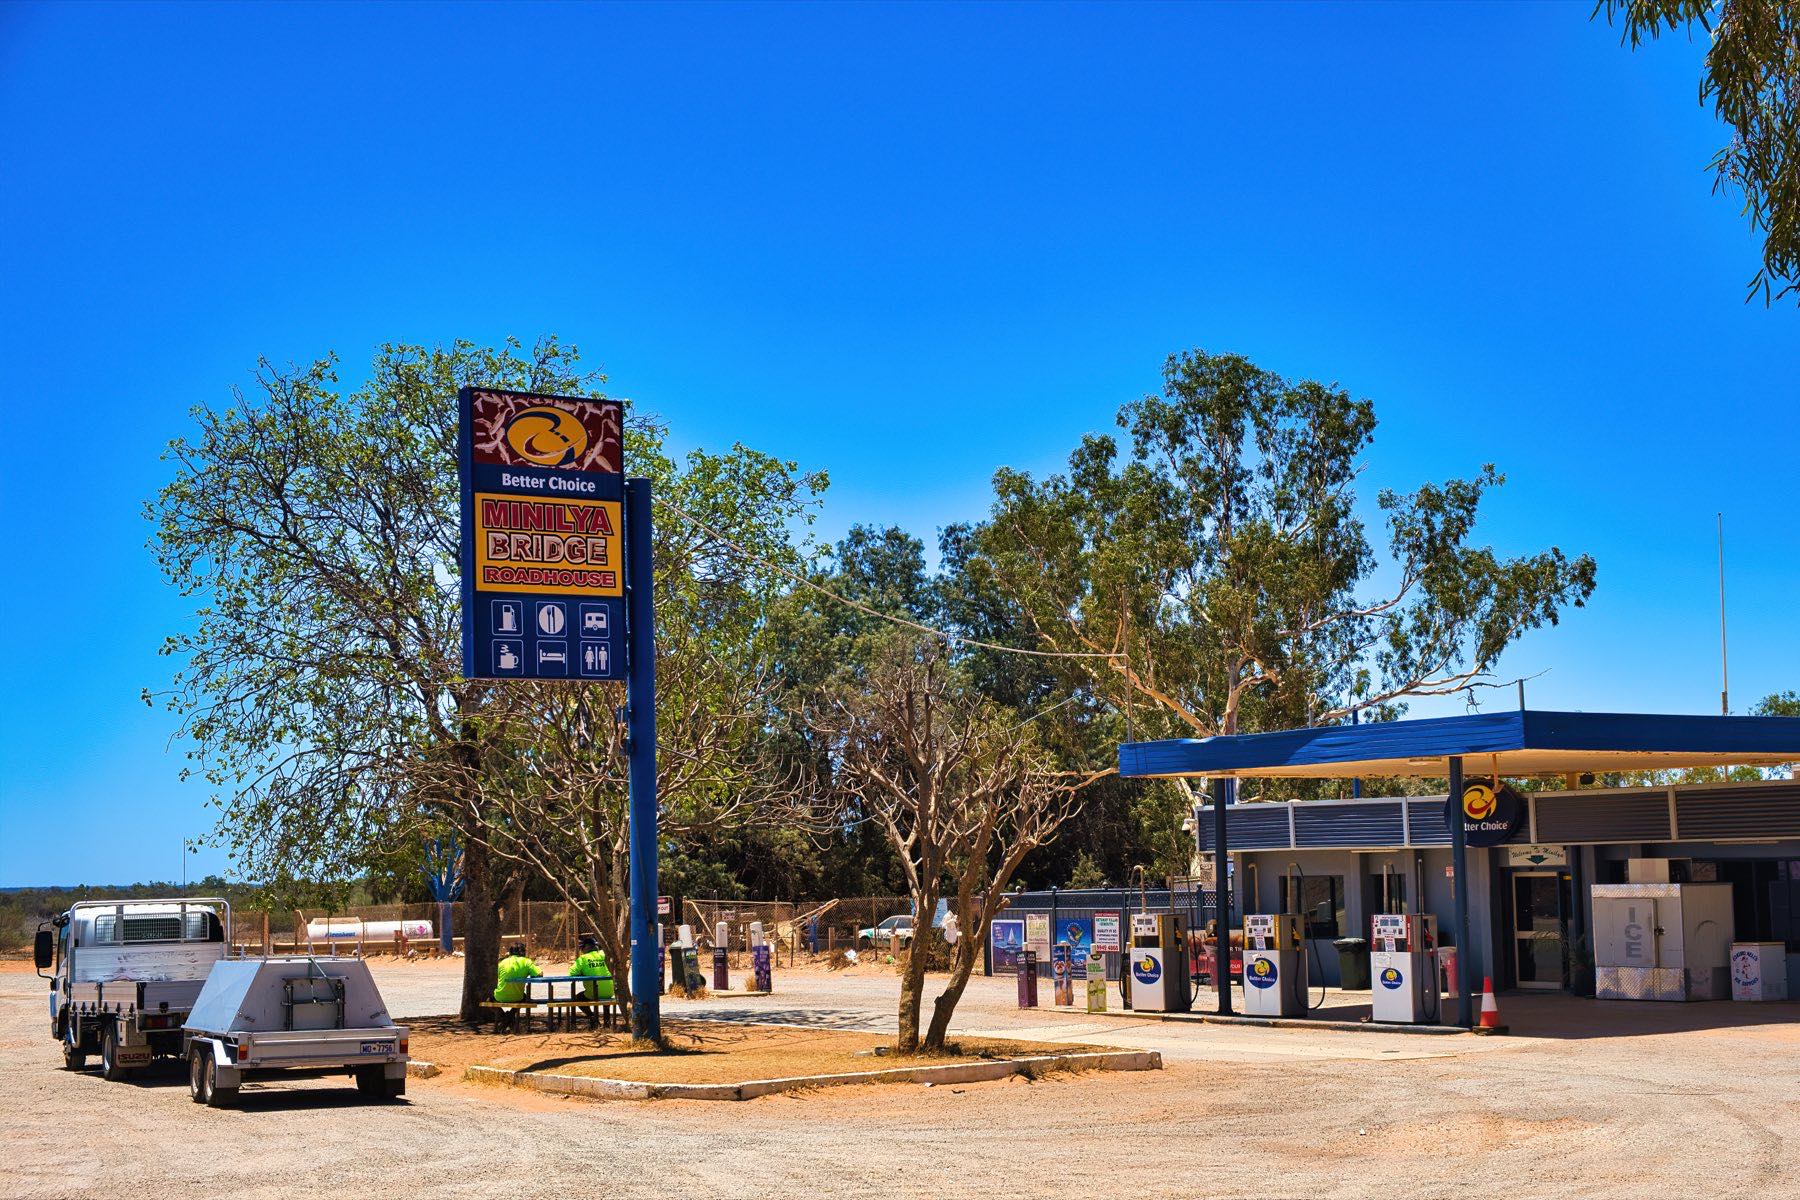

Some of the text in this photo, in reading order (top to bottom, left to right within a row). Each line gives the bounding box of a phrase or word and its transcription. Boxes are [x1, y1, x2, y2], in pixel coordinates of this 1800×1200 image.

[502, 473, 596, 492] Better Choice
[482, 499, 614, 536] MINILYA
[487, 531, 608, 566] BRIDGE
[483, 566, 616, 589] ROADHOUSE
[1480, 820, 1508, 831] Choice
[1625, 907, 1642, 958] ICE
